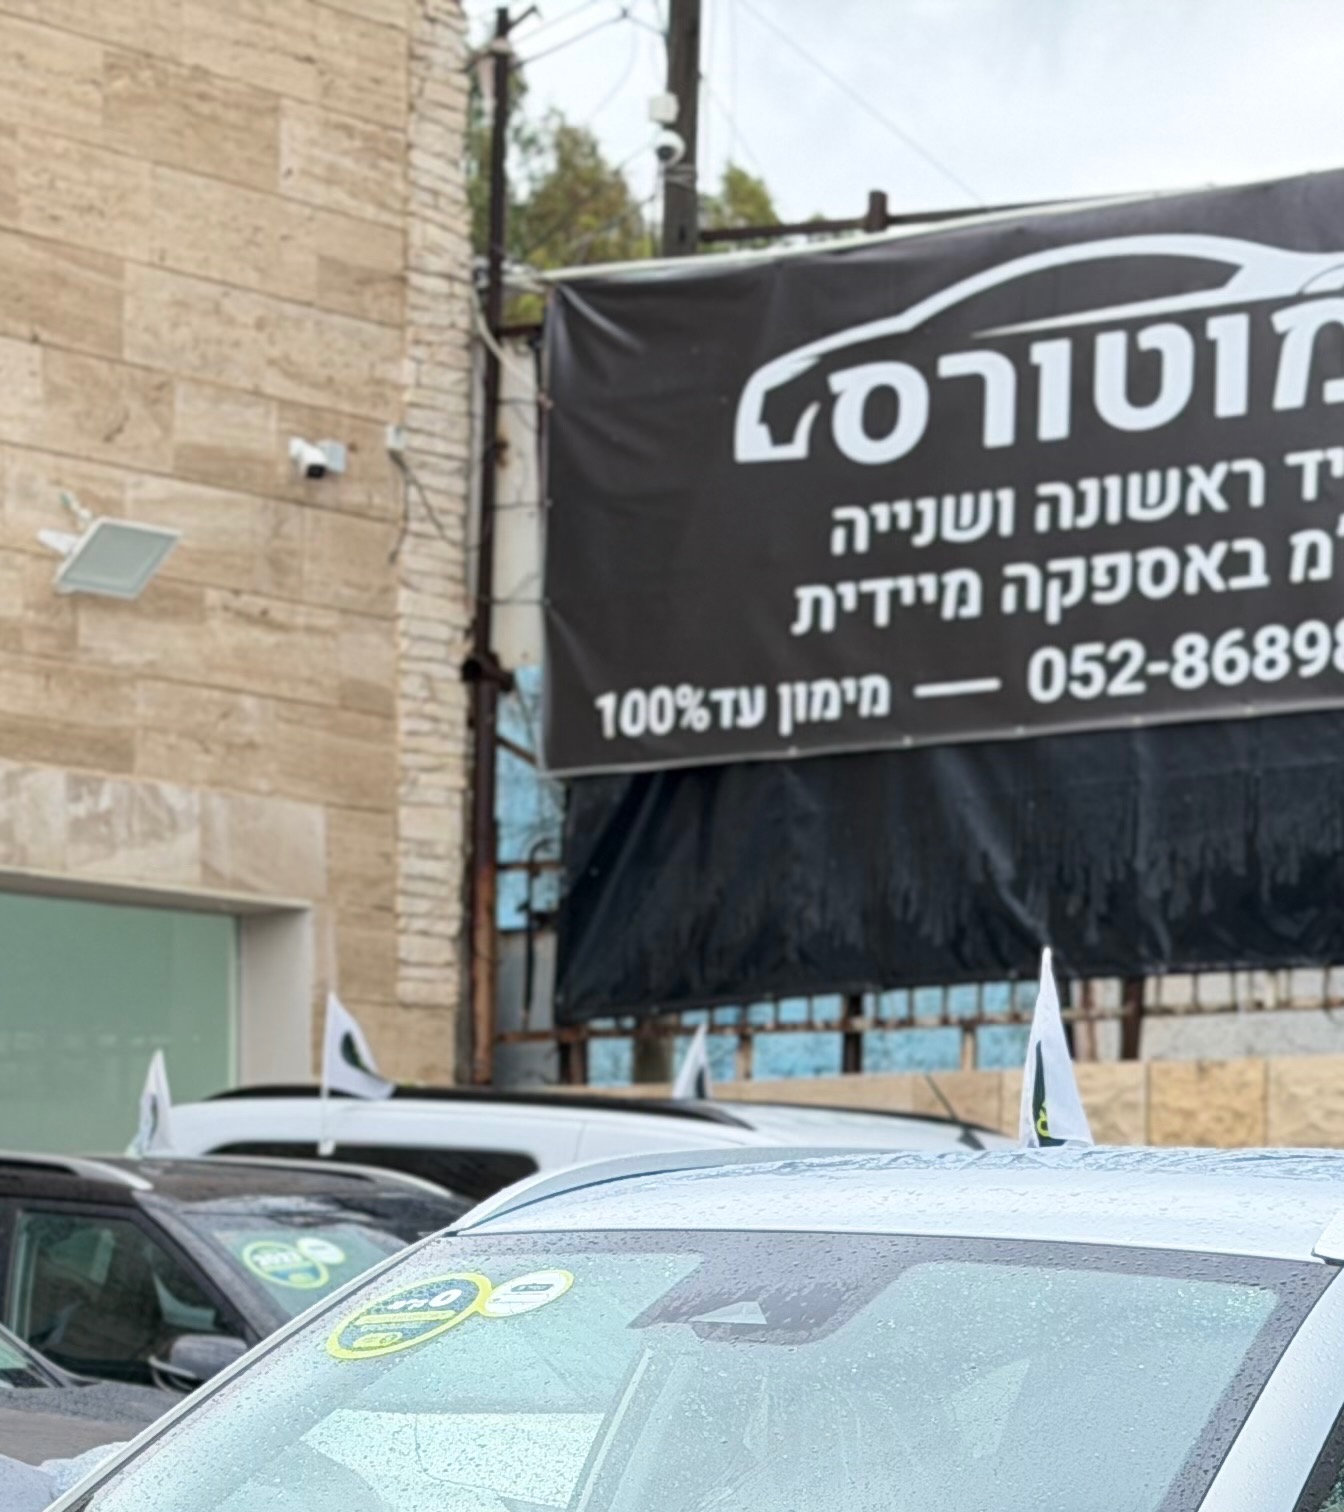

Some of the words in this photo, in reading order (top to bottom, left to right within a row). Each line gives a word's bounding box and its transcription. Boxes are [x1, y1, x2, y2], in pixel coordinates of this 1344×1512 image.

[832, 488, 1015, 555] ושנייה
[1035, 458, 1265, 532] ראשונה
[792, 569, 981, 635] מיידית
[1002, 538, 1270, 624] באספקה
[778, 675, 890, 735] מימון
